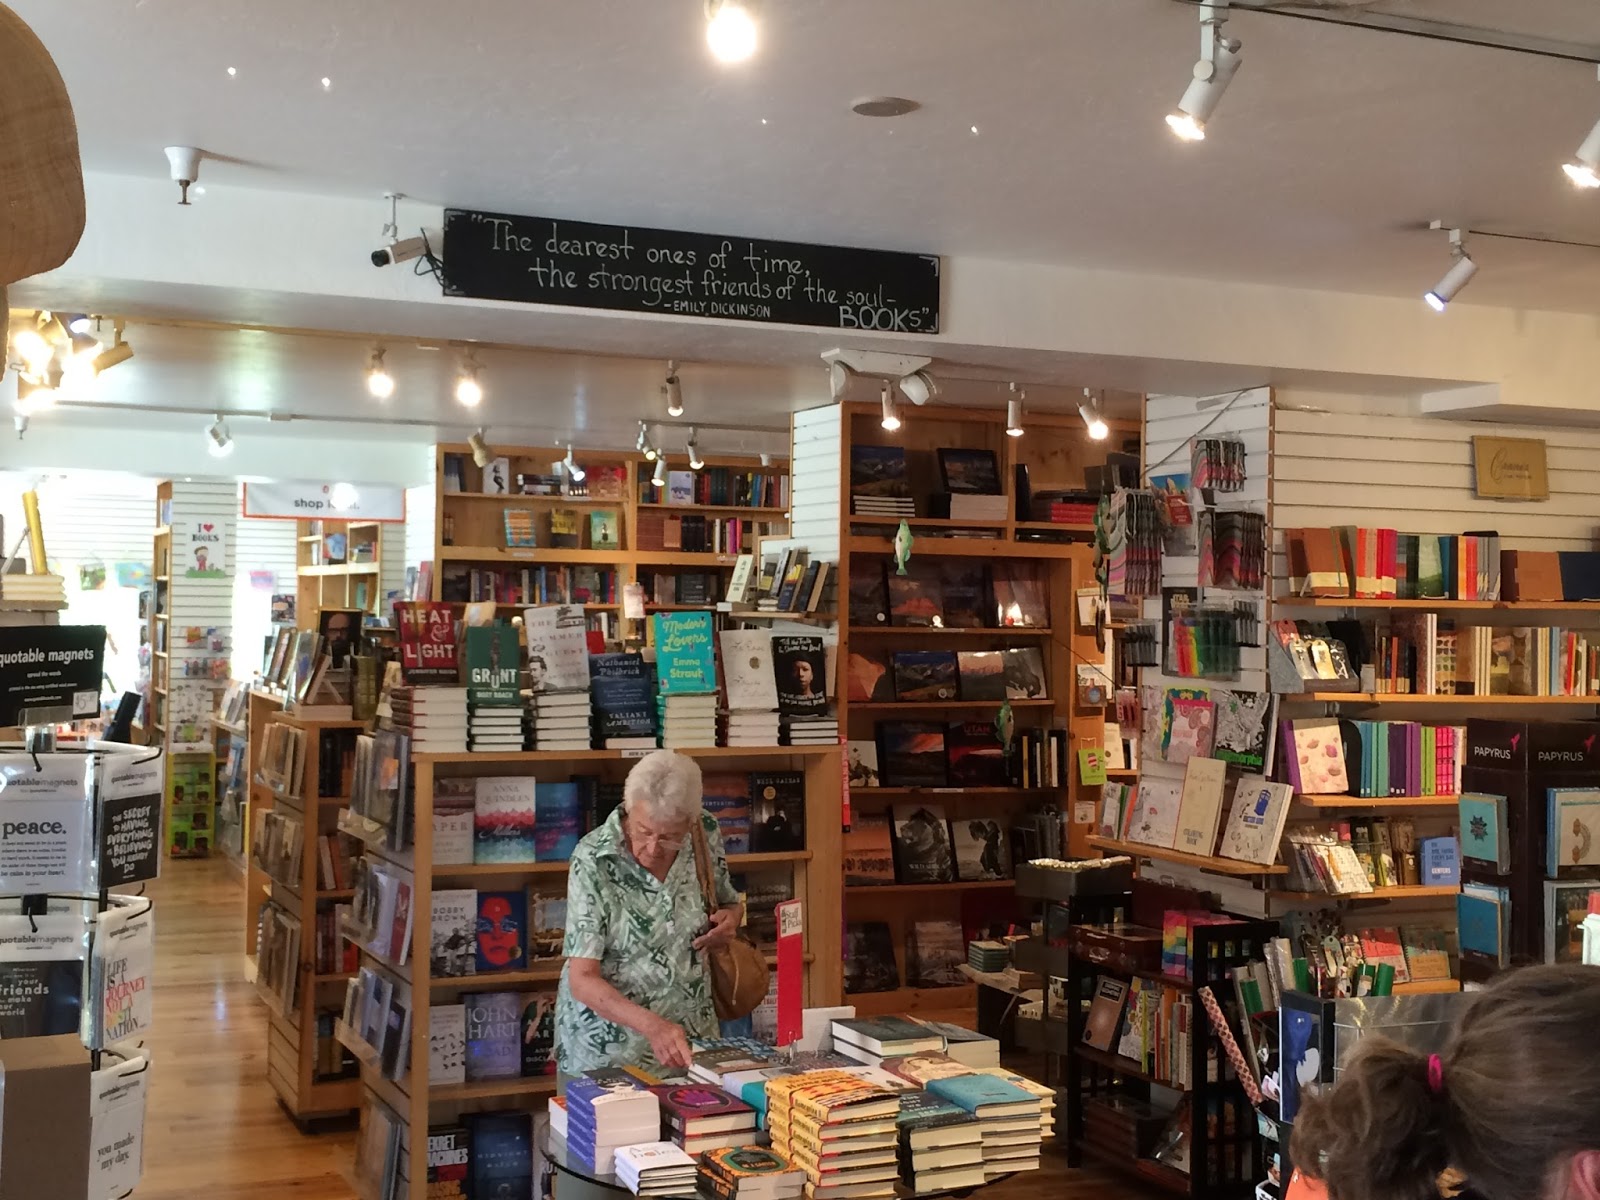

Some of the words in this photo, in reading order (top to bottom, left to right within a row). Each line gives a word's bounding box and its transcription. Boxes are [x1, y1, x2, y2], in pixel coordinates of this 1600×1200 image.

[545, 222, 634, 260] dearest
[646, 248, 696, 266] ones
[708, 240, 733, 269] of
[743, 242, 811, 277] time,
[528, 257, 578, 288] the
[588, 264, 694, 306] strongest
[701, 269, 771, 299] friends
[776, 275, 797, 301] of
[804, 277, 839, 303] the
[710, 301, 771, 319] DICKINSON
[294, 498, 324, 510] shop
[192, 534, 219, 542] BOOKS
[402, 609, 452, 624] HEAT
[430, 624, 450, 642] &
[662, 618, 707, 635] Modern
[662, 634, 708, 652] Lovers
[0, 648, 46, 668] quotable
[48, 648, 94, 665] magnets
[406, 643, 455, 668] LIGHT
[673, 658, 700, 666] Emma
[472, 667, 518, 689] GRUNT
[670, 668, 704, 679] Straub
[608, 711, 647, 719] VALIANT
[1474, 746, 1511, 760] PAPYRUS
[1538, 751, 1585, 762] PAPYRUS
[2, 821, 67, 840] peace.
[431, 914, 466, 922] BROWN
[433, 907, 464, 915] BOBBY
[106, 957, 128, 977] LIFE
[18, 978, 39, 986] your
[467, 1007, 518, 1025] JOHN
[469, 1022, 520, 1040] HART
[97, 1145, 112, 1162] you
[113, 1132, 135, 1151] made
